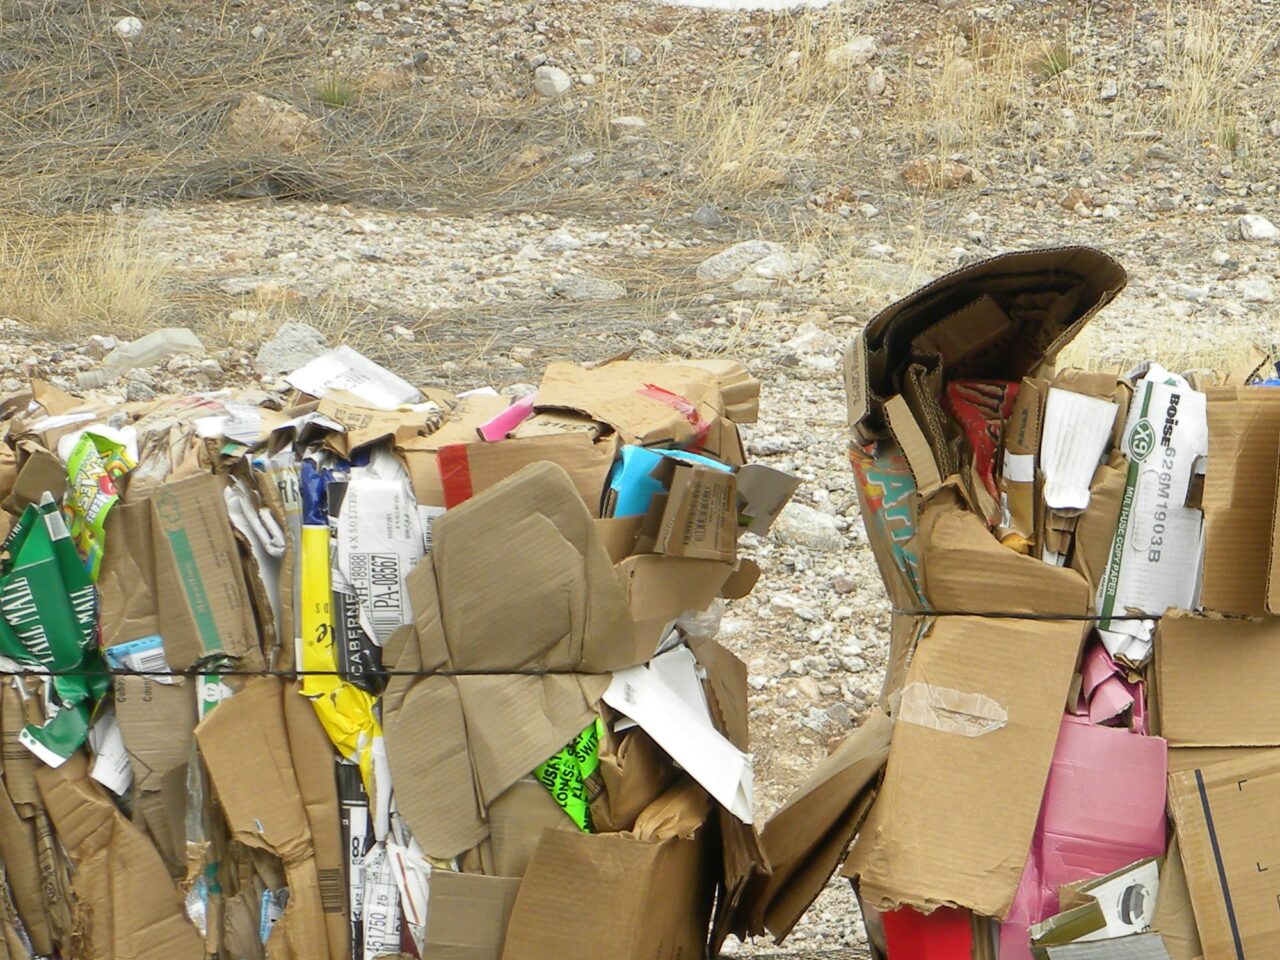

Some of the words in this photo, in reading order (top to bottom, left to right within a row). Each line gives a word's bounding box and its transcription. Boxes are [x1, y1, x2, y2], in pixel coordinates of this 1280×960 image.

[1132, 426, 1151, 456] X9
[1120, 486, 1134, 536] MULTI-USE
[351, 535, 358, 543] X
[1114, 537, 1125, 566] COPY
[371, 554, 400, 609] PA-08567
[1106, 566, 1120, 596] PAPER
[2, 577, 40, 625] MALL
